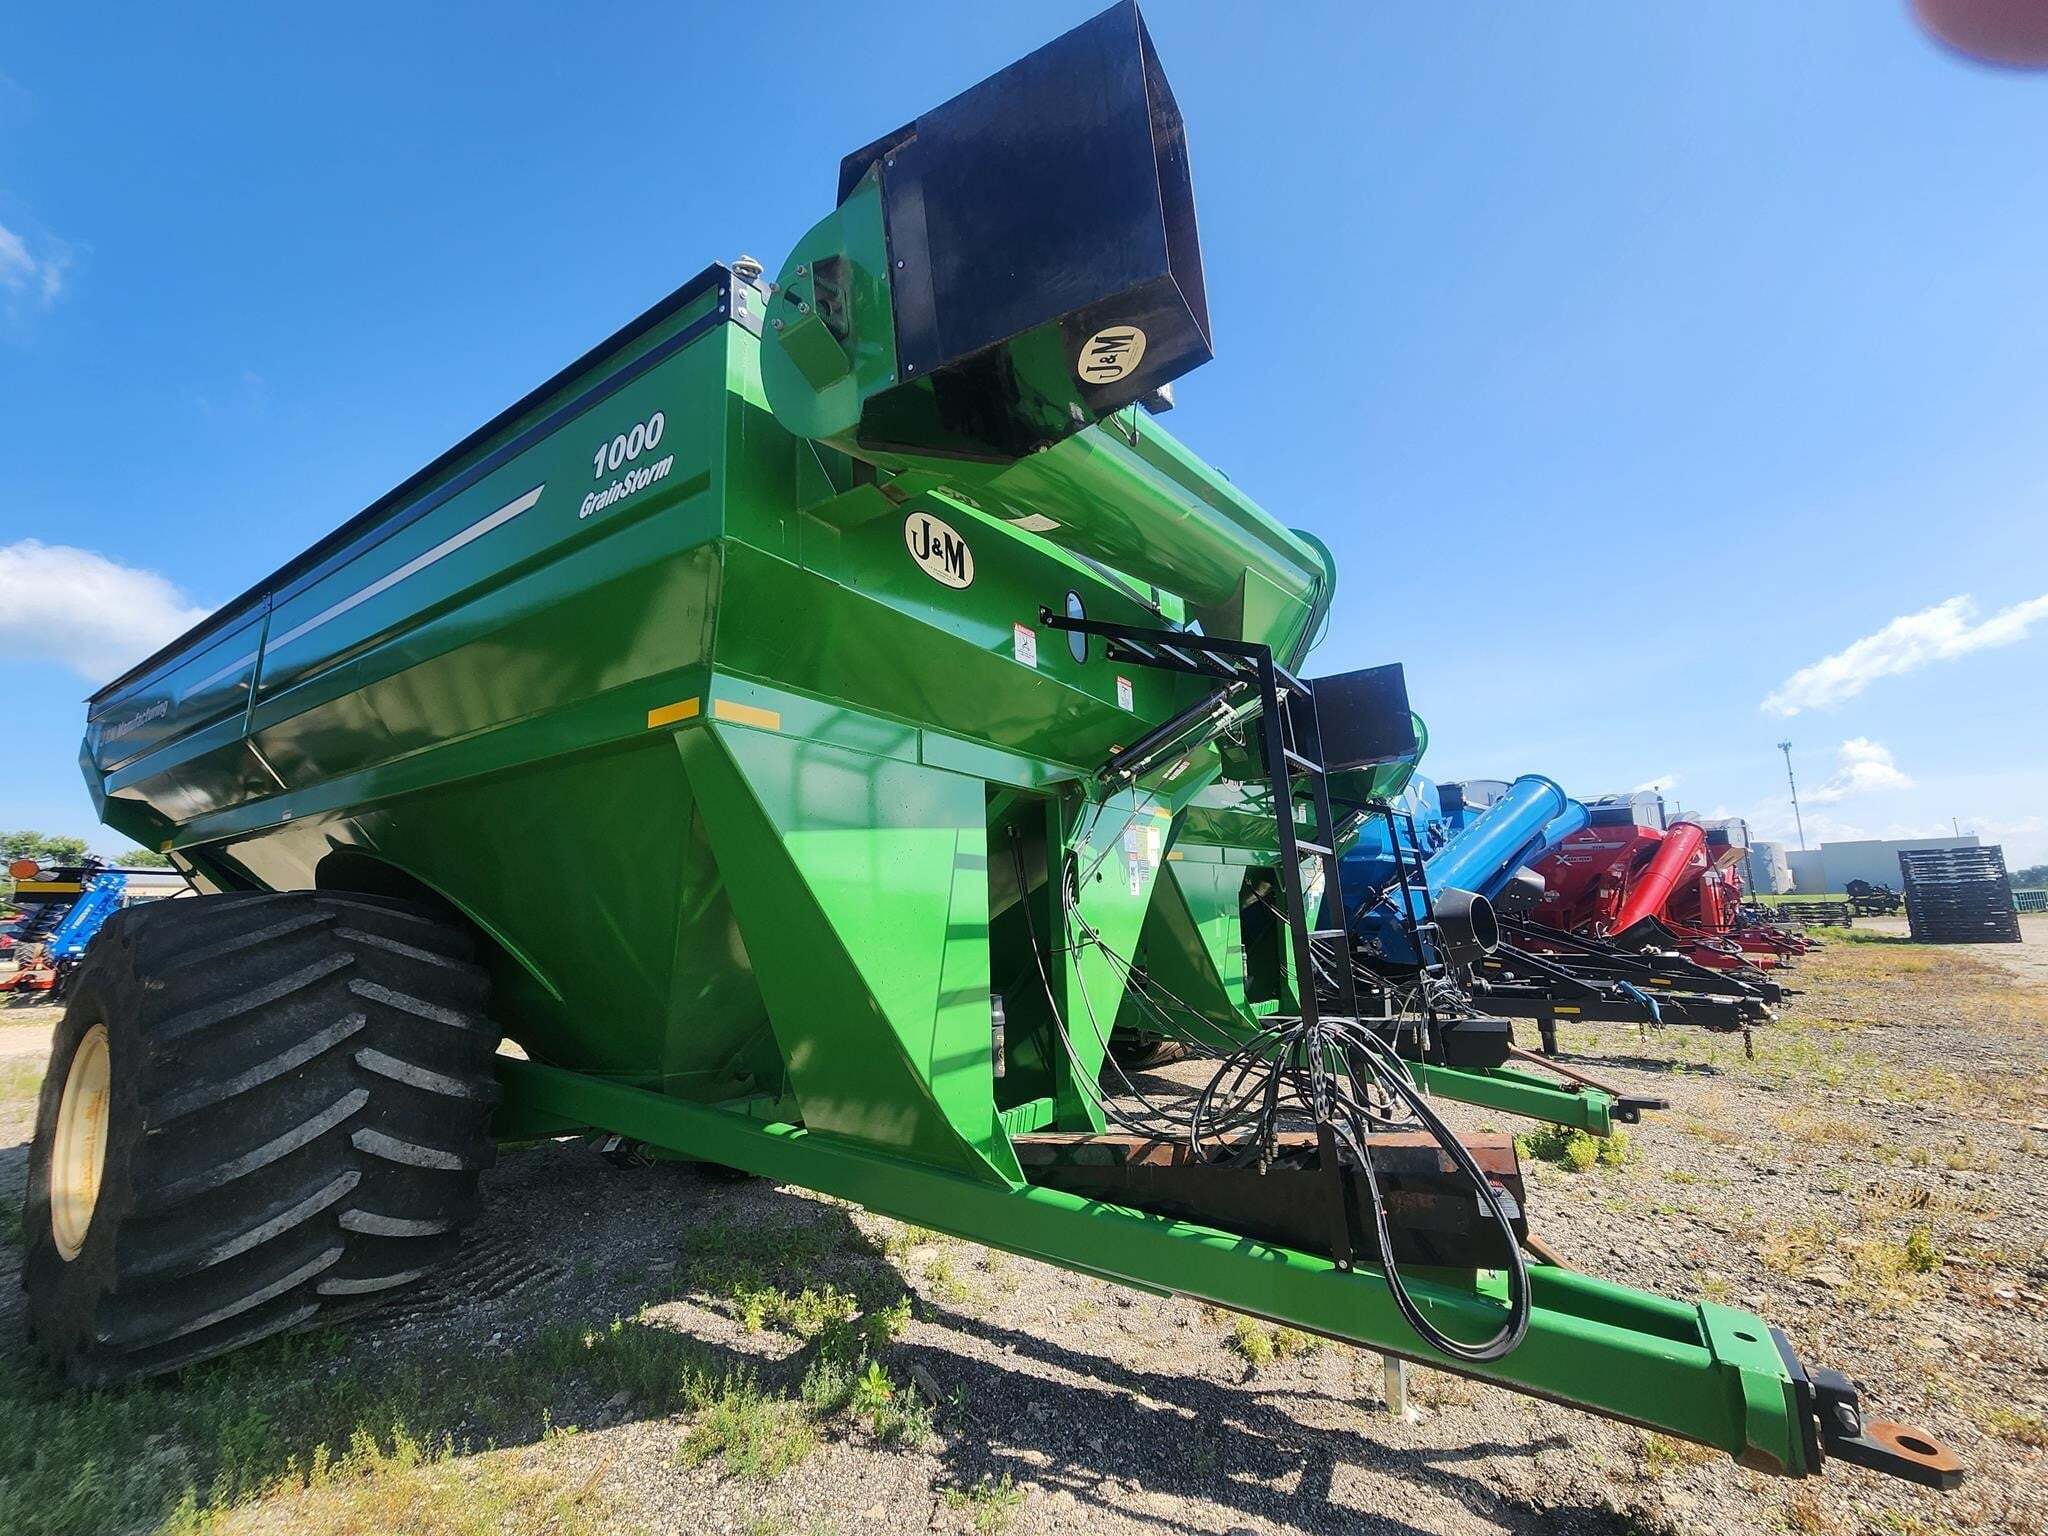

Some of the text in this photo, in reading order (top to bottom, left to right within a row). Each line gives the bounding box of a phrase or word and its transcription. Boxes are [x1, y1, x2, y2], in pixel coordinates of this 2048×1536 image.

[1086, 333, 1135, 379] J&M
[594, 412, 664, 479] 1000
[579, 455, 674, 519] GrainStorm
[911, 518, 966, 581] J&M
